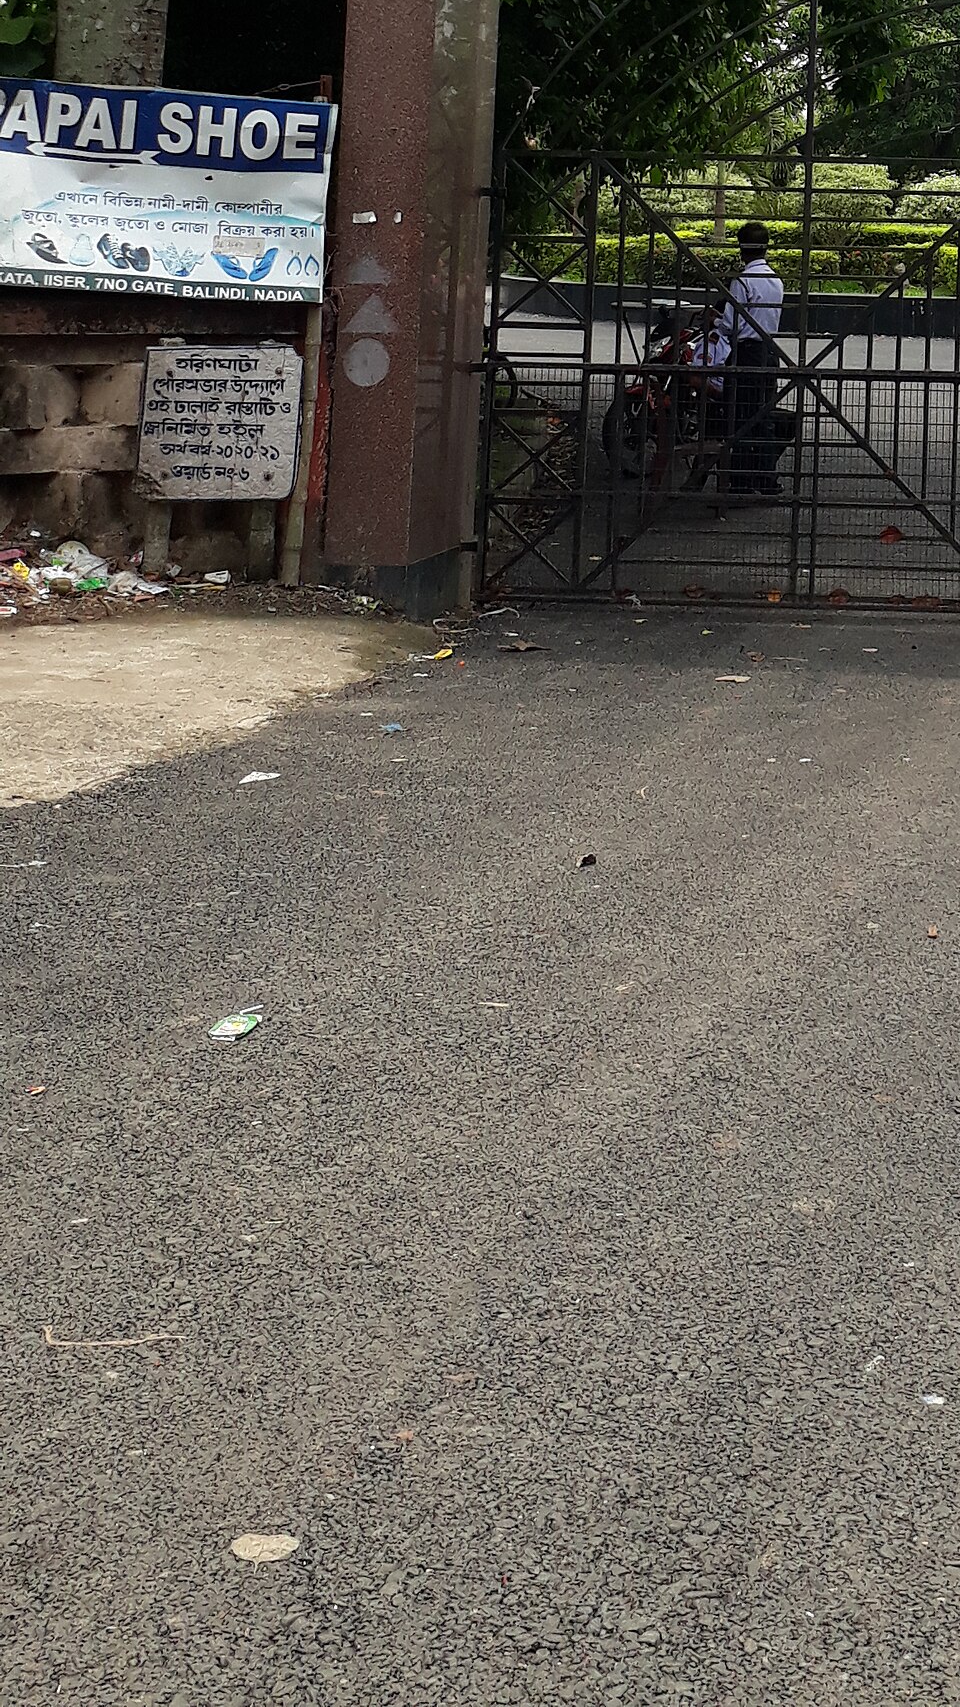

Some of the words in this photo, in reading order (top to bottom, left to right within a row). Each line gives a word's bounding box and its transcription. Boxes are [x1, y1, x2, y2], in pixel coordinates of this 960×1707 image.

[0, 89, 138, 150] APAI
[157, 102, 320, 161] SHOE
[55, 192, 98, 205] এখানে
[103, 191, 144, 207] বিভিন্ন
[214, 199, 283, 215] কোম্পানীর
[65, 213, 110, 228] স্কুলের
[113, 216, 149, 232] জুতো
[154, 220, 166, 231] ও
[172, 221, 208, 235] মোজা
[260, 226, 286, 238] করা
[94, 277, 128, 291] 7NO
[254, 289, 304, 301] NADIA
